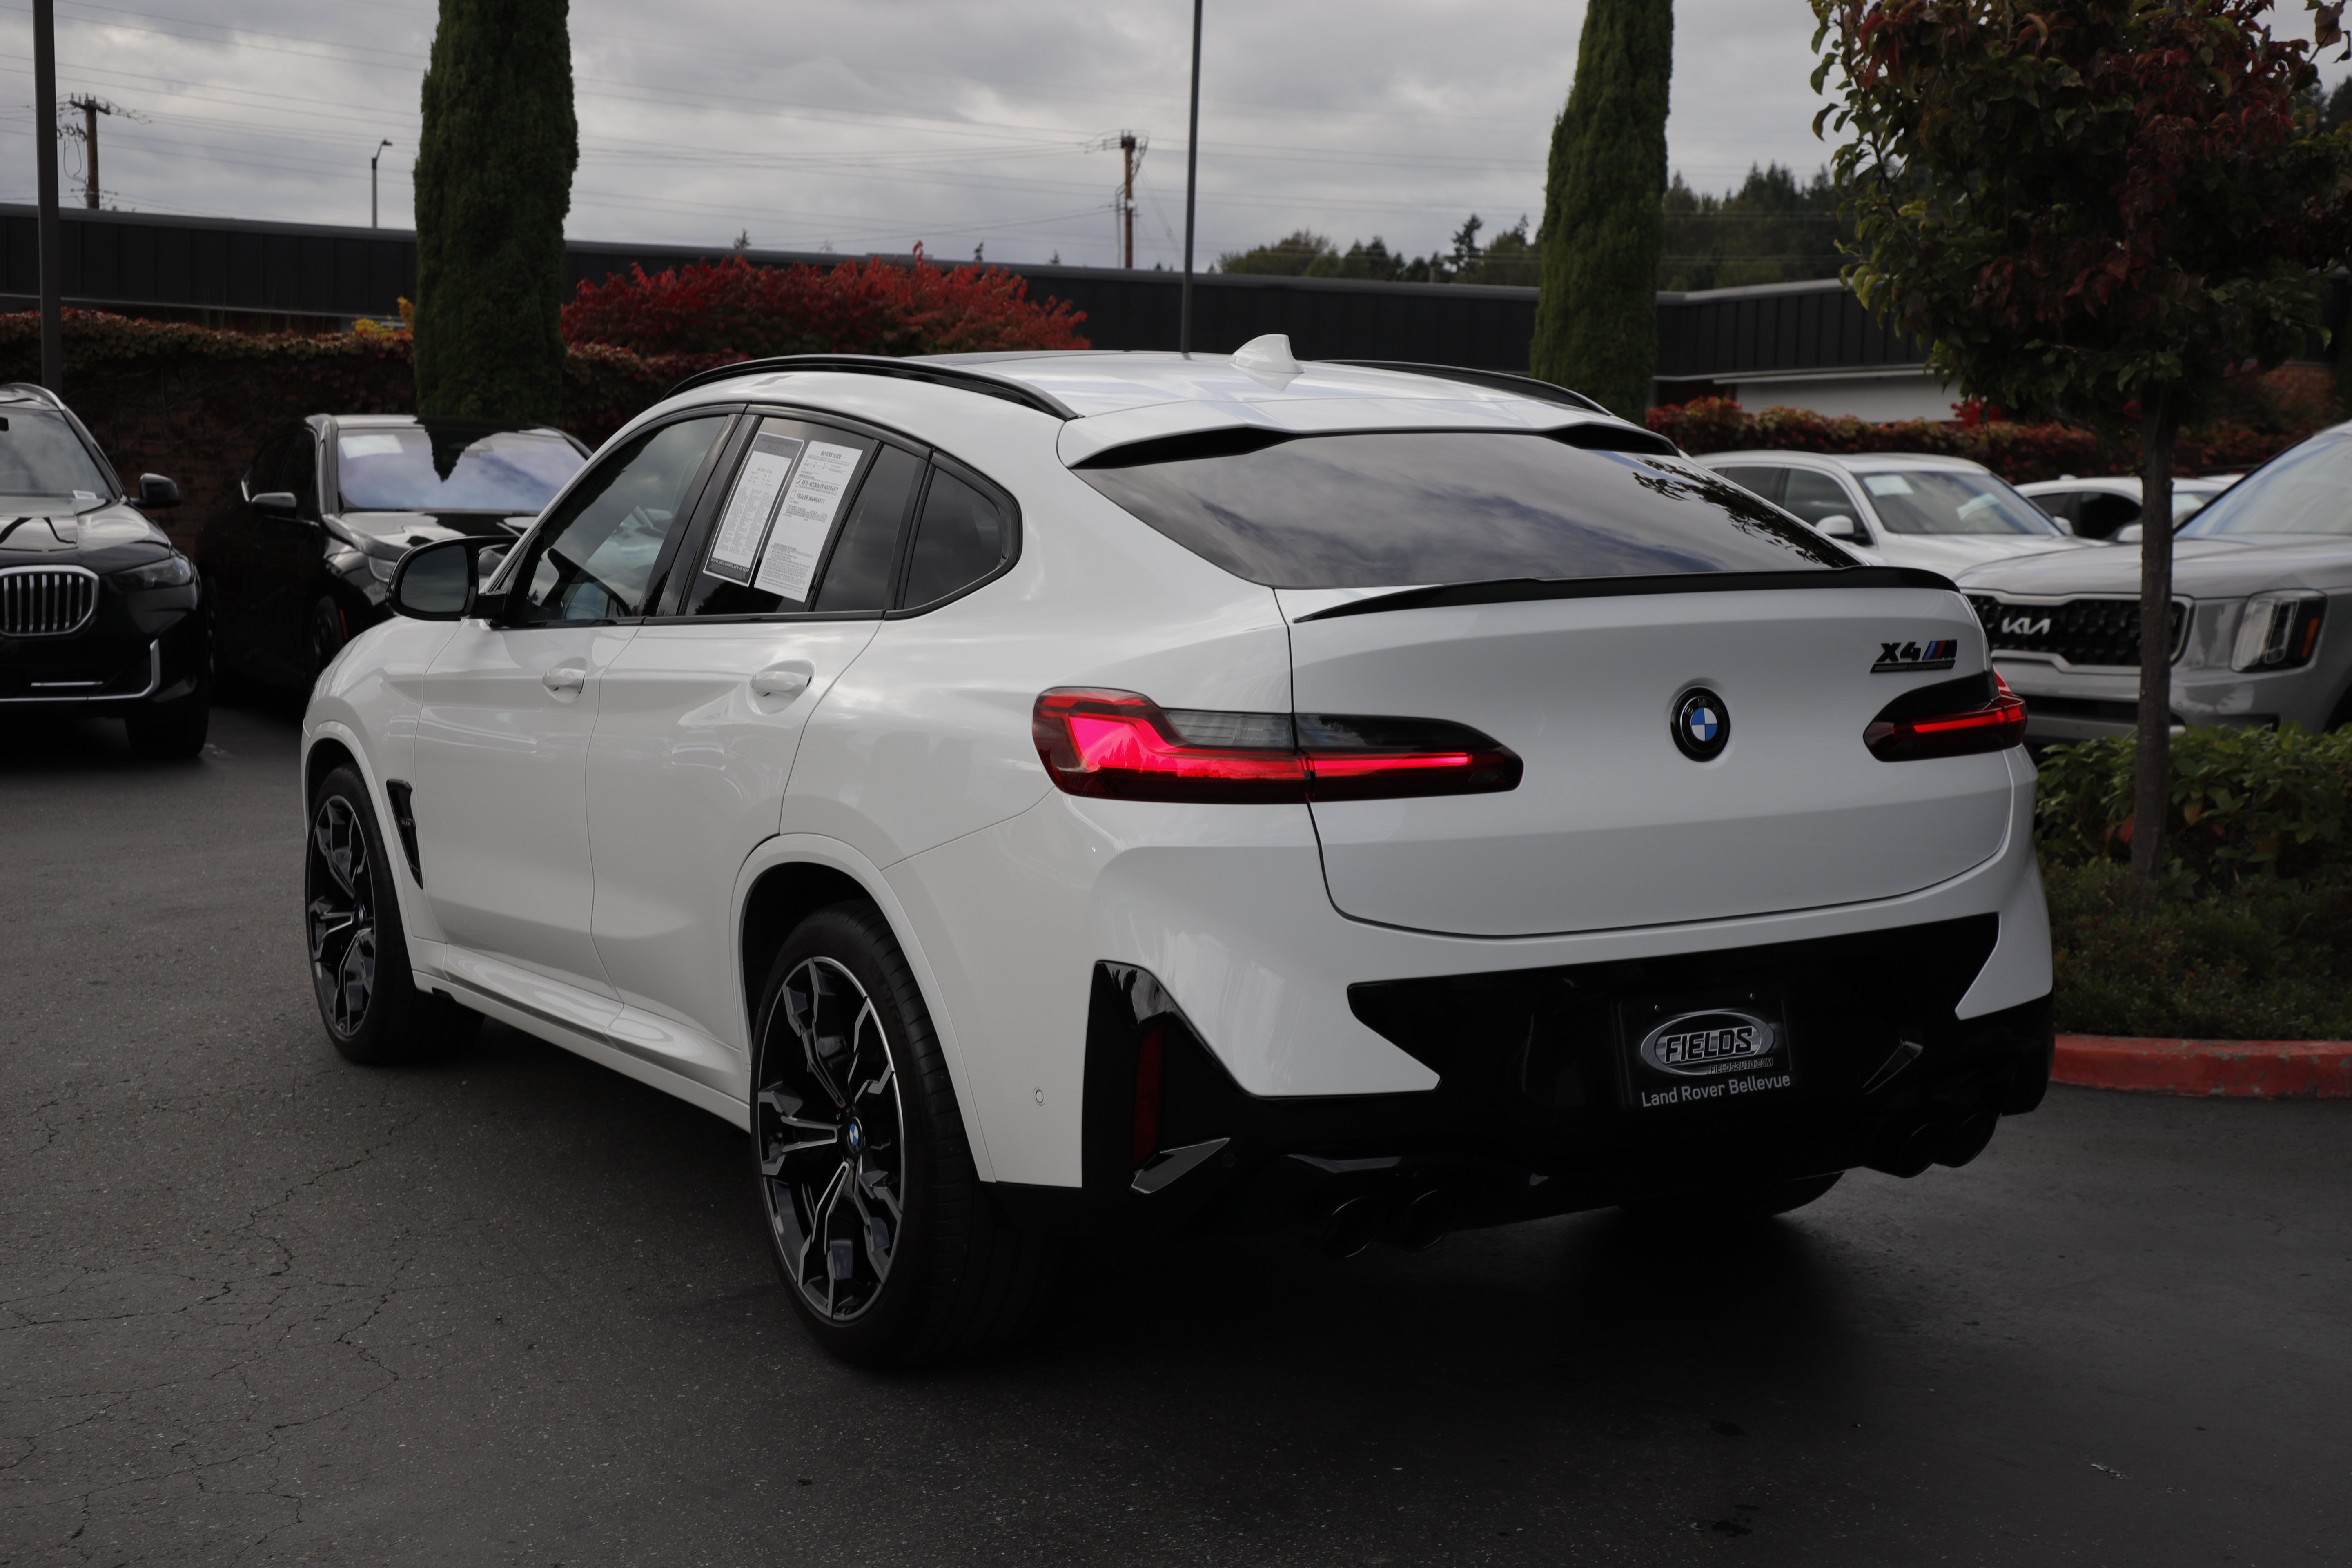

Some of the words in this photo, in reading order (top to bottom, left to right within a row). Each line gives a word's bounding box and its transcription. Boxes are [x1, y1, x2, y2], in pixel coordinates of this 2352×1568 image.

[796, 492, 809, 500] DEALER
[808, 495, 826, 504] WARRANTY
[2001, 617, 2051, 635] KIA
[1908, 662, 1953, 670] competition
[1684, 698, 1721, 715] BMW
[1664, 1025, 1753, 1064] FIELDS
[1641, 1087, 1678, 1107] Land
[1682, 1083, 1725, 1101] Rover
[1728, 1074, 1791, 1094] Bellevue
